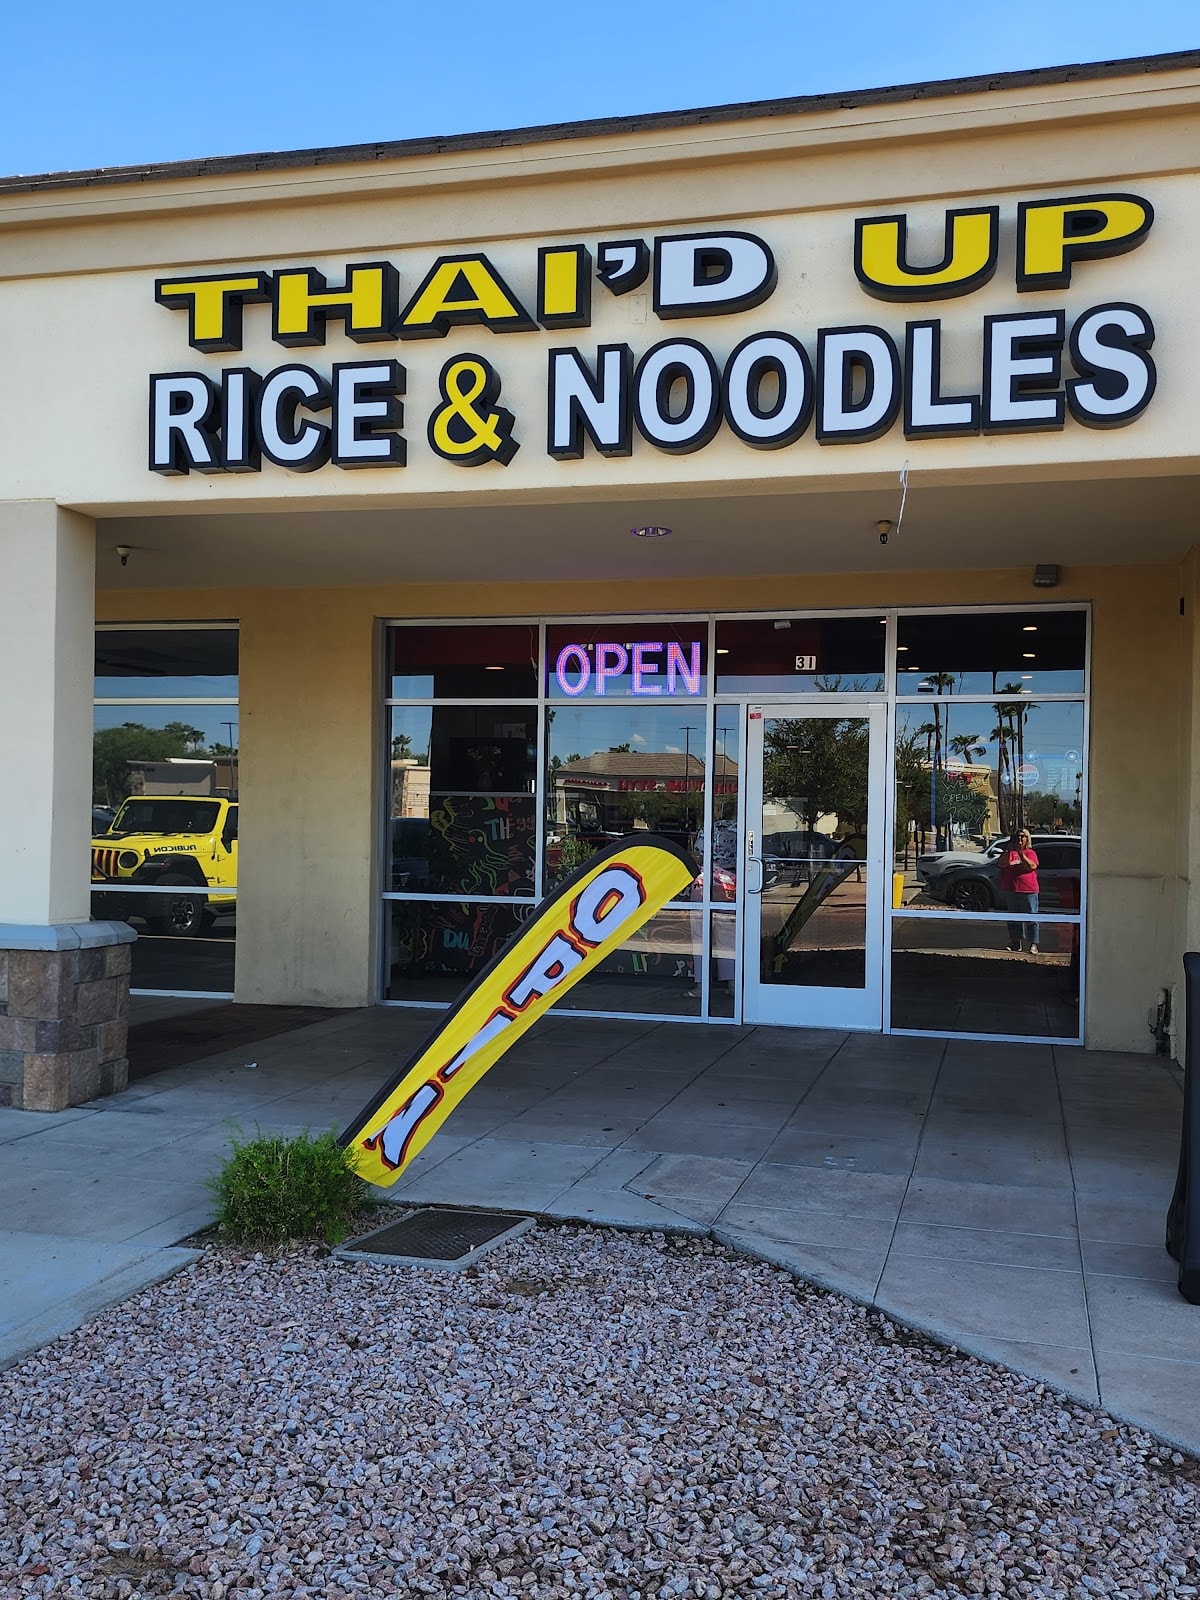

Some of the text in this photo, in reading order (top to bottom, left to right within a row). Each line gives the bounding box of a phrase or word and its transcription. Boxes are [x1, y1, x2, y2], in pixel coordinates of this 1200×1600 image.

[155, 193, 1154, 350] THAI'D UP
[149, 302, 1156, 475] RICE & NOODLES
[556, 641, 701, 696] OPEN
[796, 656, 815, 669] 31
[942, 779, 965, 789] WE
[362, 862, 647, 1171] OP
